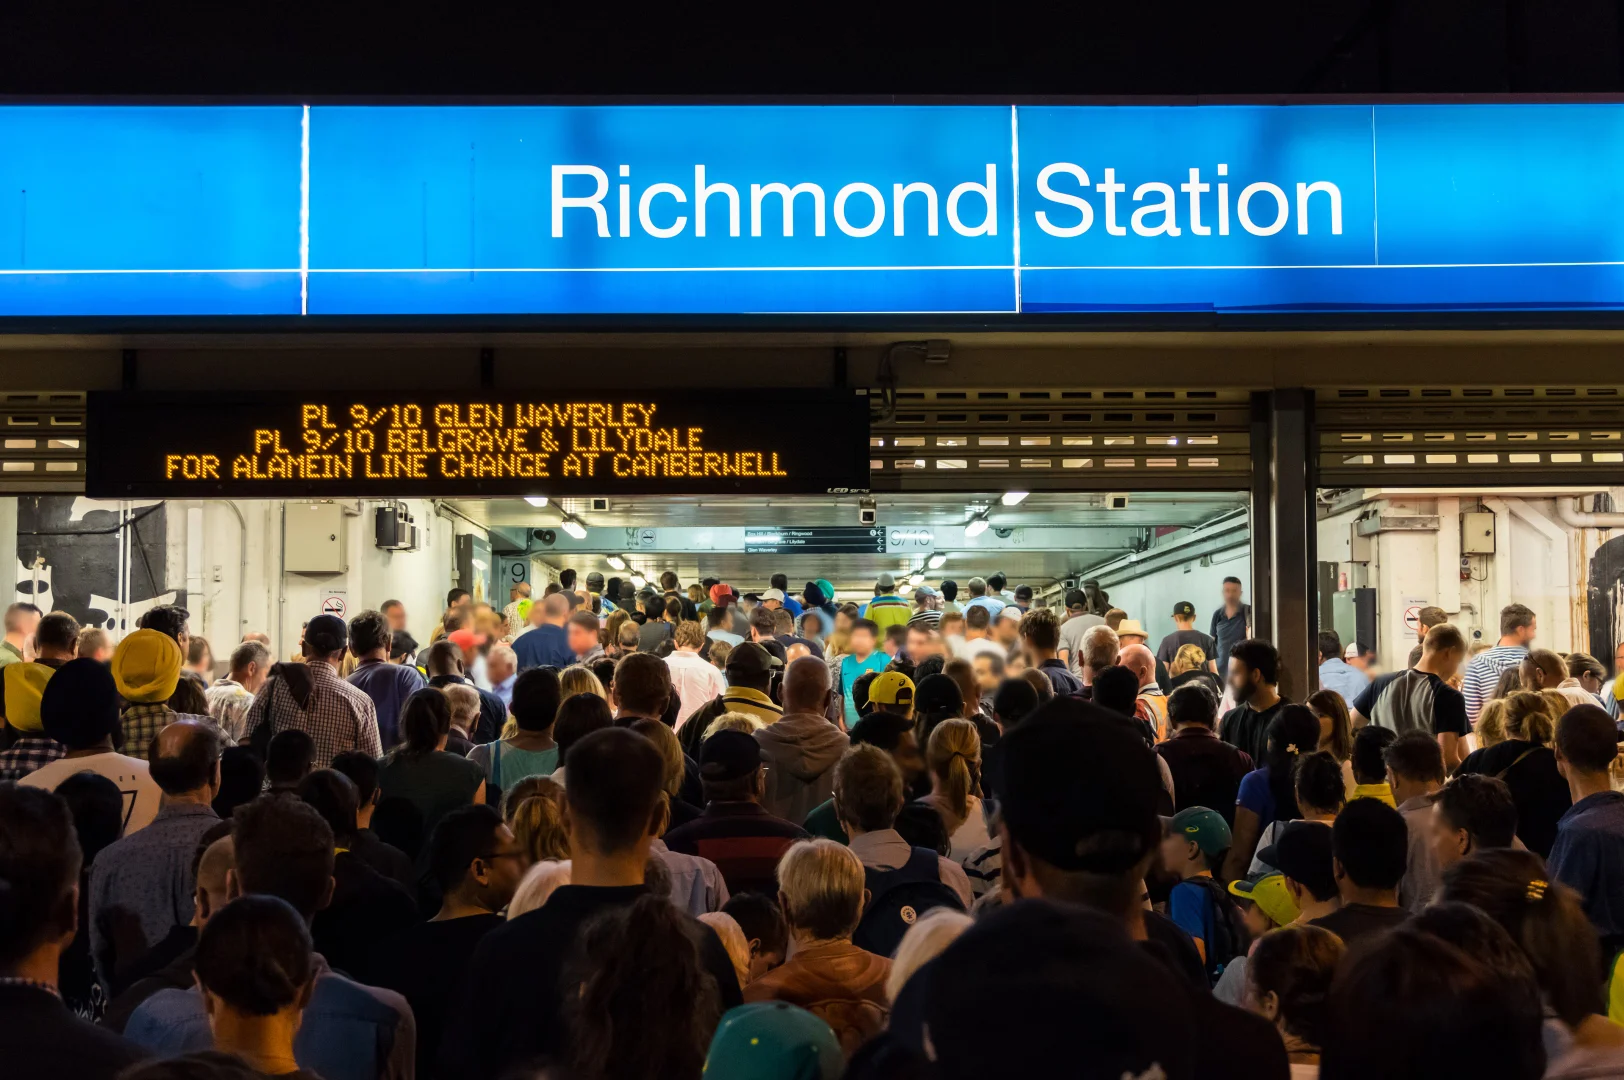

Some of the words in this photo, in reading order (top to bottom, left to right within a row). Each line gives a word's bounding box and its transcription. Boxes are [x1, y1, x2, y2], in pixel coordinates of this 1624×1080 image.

[551, 163, 998, 239] Richmond
[1034, 162, 1343, 238] Station
[302, 403, 337, 429] PL
[350, 403, 423, 429] 9/10
[434, 403, 503, 428] GLEN
[516, 403, 656, 427] WAVERLEY
[255, 429, 289, 454] PL
[303, 429, 375, 454] 9/10
[388, 429, 528, 453] BELGRAVE
[541, 428, 559, 452] &
[572, 428, 703, 452] LILYDALE
[166, 455, 220, 479] FOR
[232, 455, 353, 479] ALAMEIN
[365, 454, 428, 478] LINE
[440, 454, 550, 477] CHANGE
[563, 453, 600, 477] AT
[613, 453, 788, 477] CAMBERWELL
[890, 529, 930, 546] 9/10
[511, 562, 526, 584] 9
